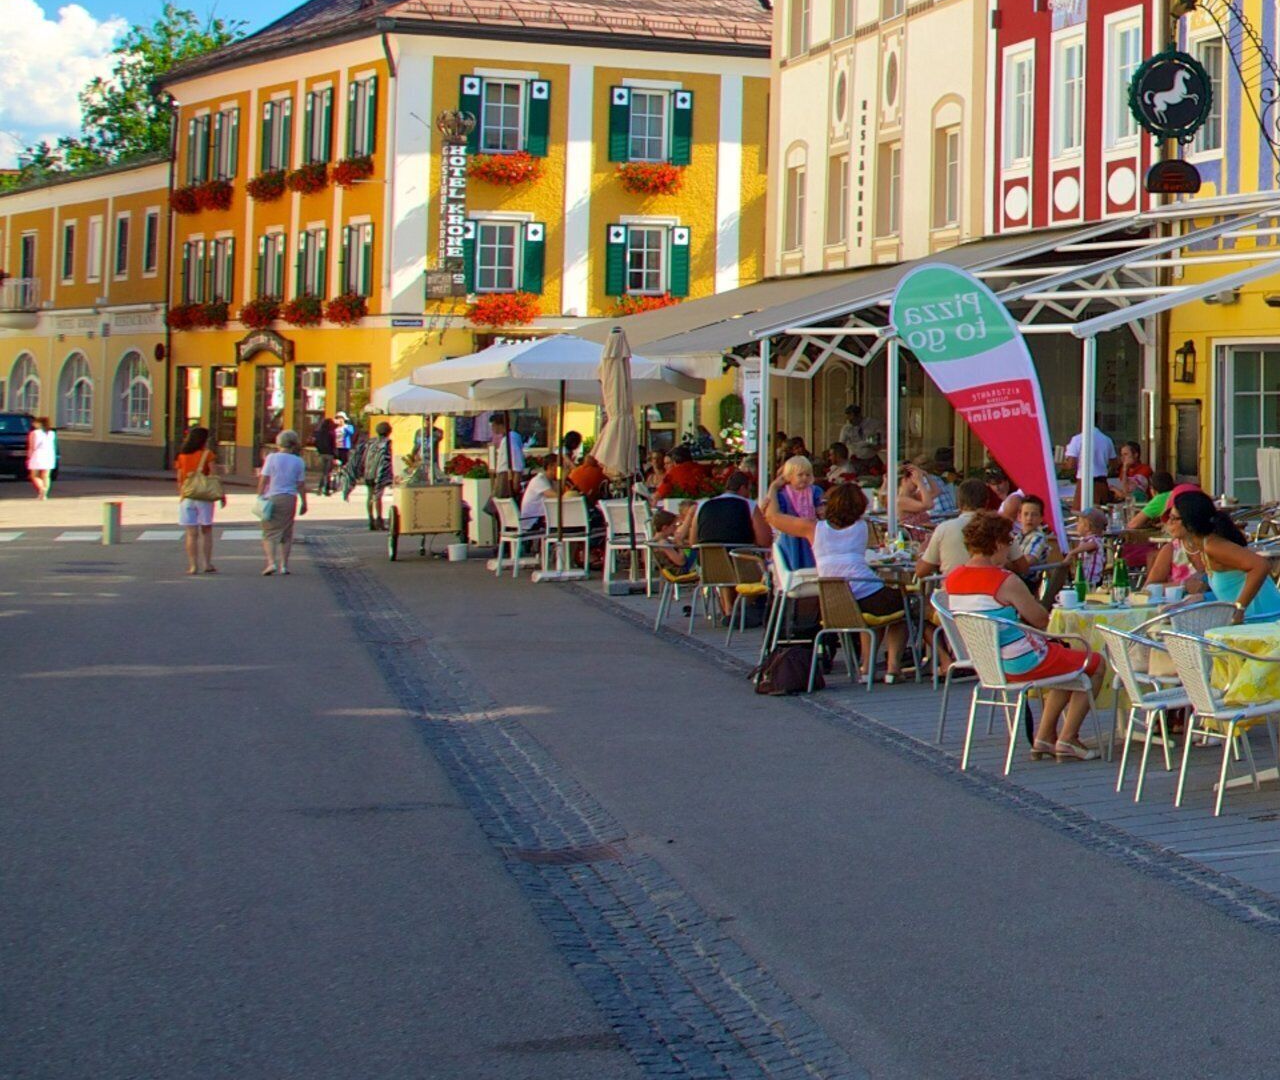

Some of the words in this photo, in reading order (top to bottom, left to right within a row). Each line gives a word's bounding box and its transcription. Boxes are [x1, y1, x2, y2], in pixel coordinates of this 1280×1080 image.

[448, 145, 467, 198] HOTEL
[856, 99, 868, 248] RESTAURANT
[446, 203, 465, 257] KRONE
